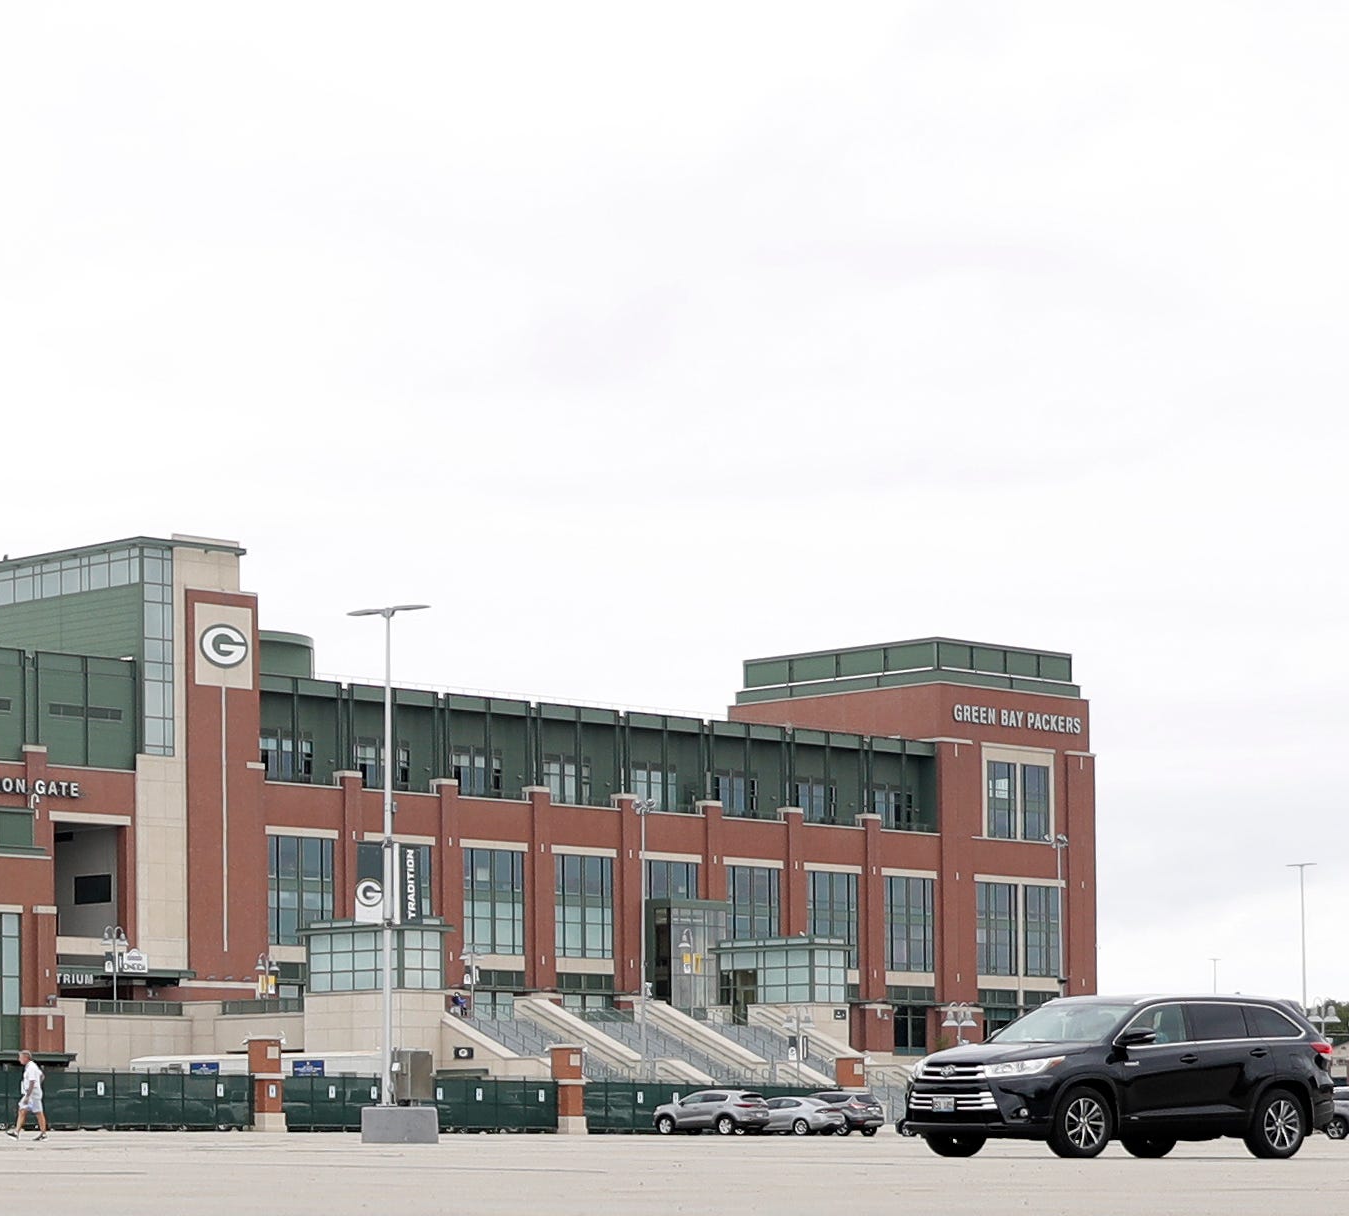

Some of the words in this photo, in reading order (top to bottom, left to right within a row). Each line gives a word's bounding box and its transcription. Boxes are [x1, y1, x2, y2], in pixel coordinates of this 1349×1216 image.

[202, 626, 247, 665] G
[953, 703, 997, 725] GREEN
[1000, 709, 1024, 728] BAY
[1027, 712, 1081, 734] PACKERS
[35, 779, 79, 798] GATE
[356, 880, 382, 905] G
[405, 848, 417, 920] TRADITION
[55, 972, 94, 985] TRIUM
